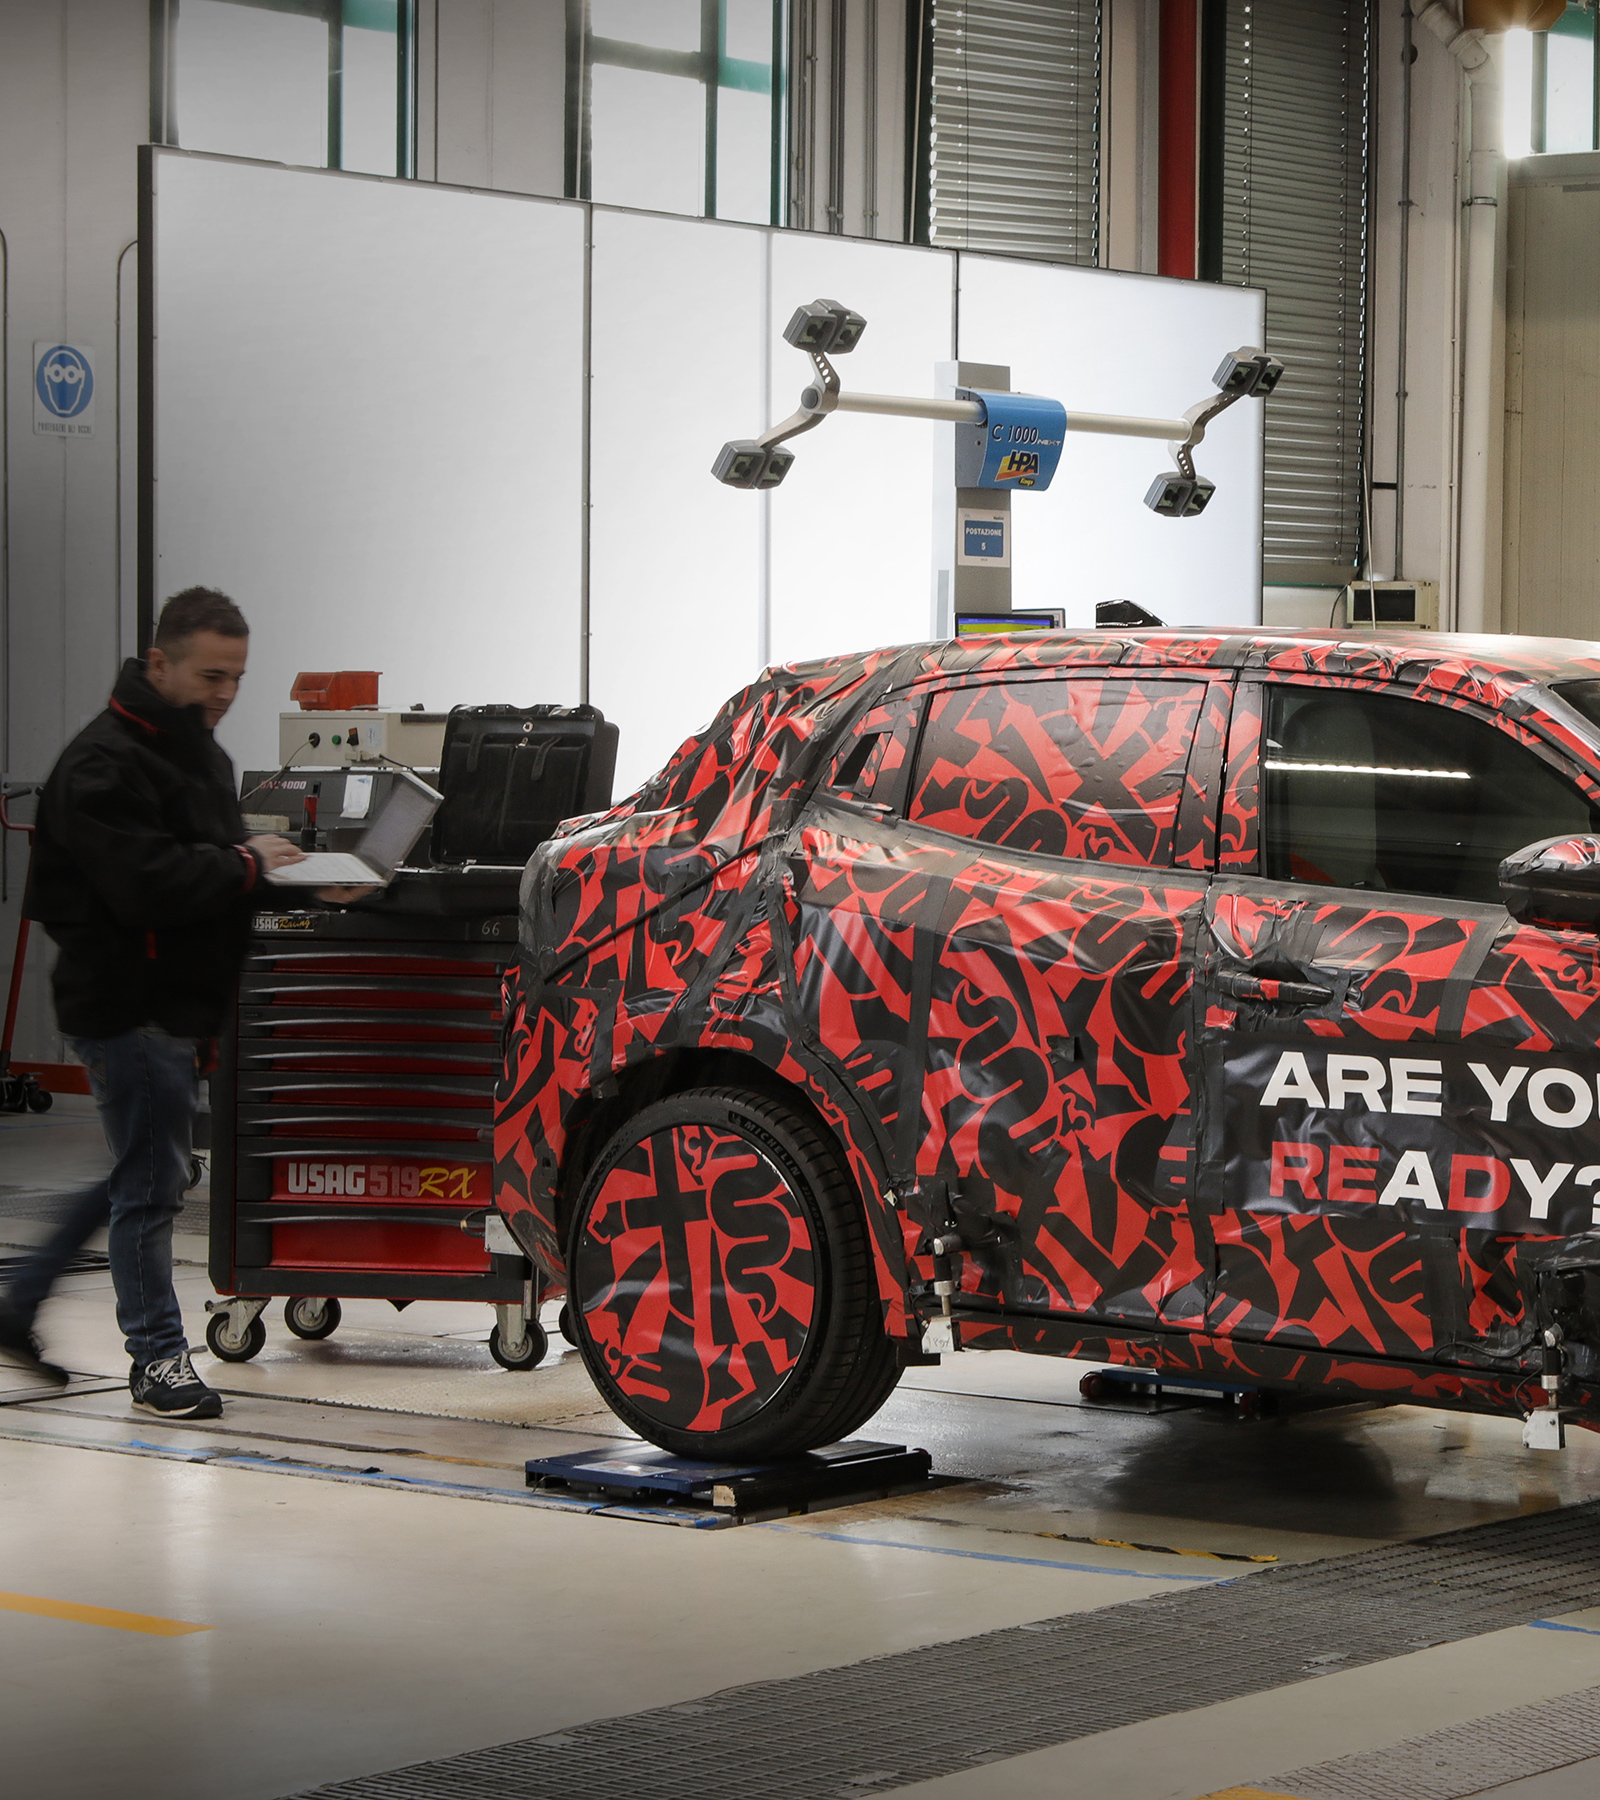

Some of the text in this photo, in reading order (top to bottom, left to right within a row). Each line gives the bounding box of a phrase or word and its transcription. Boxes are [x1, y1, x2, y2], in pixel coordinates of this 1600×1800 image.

[1008, 425, 1039, 445] 1000
[1007, 450, 1040, 475] HPA
[965, 527, 1003, 537] POSTAZIONE
[981, 542, 987, 551] 5
[281, 780, 307, 790] 4000
[481, 920, 501, 936] 66
[1259, 1051, 1443, 1117] ARE
[743, 1117, 801, 1178] MICHELIN
[288, 1162, 366, 1196] USAG
